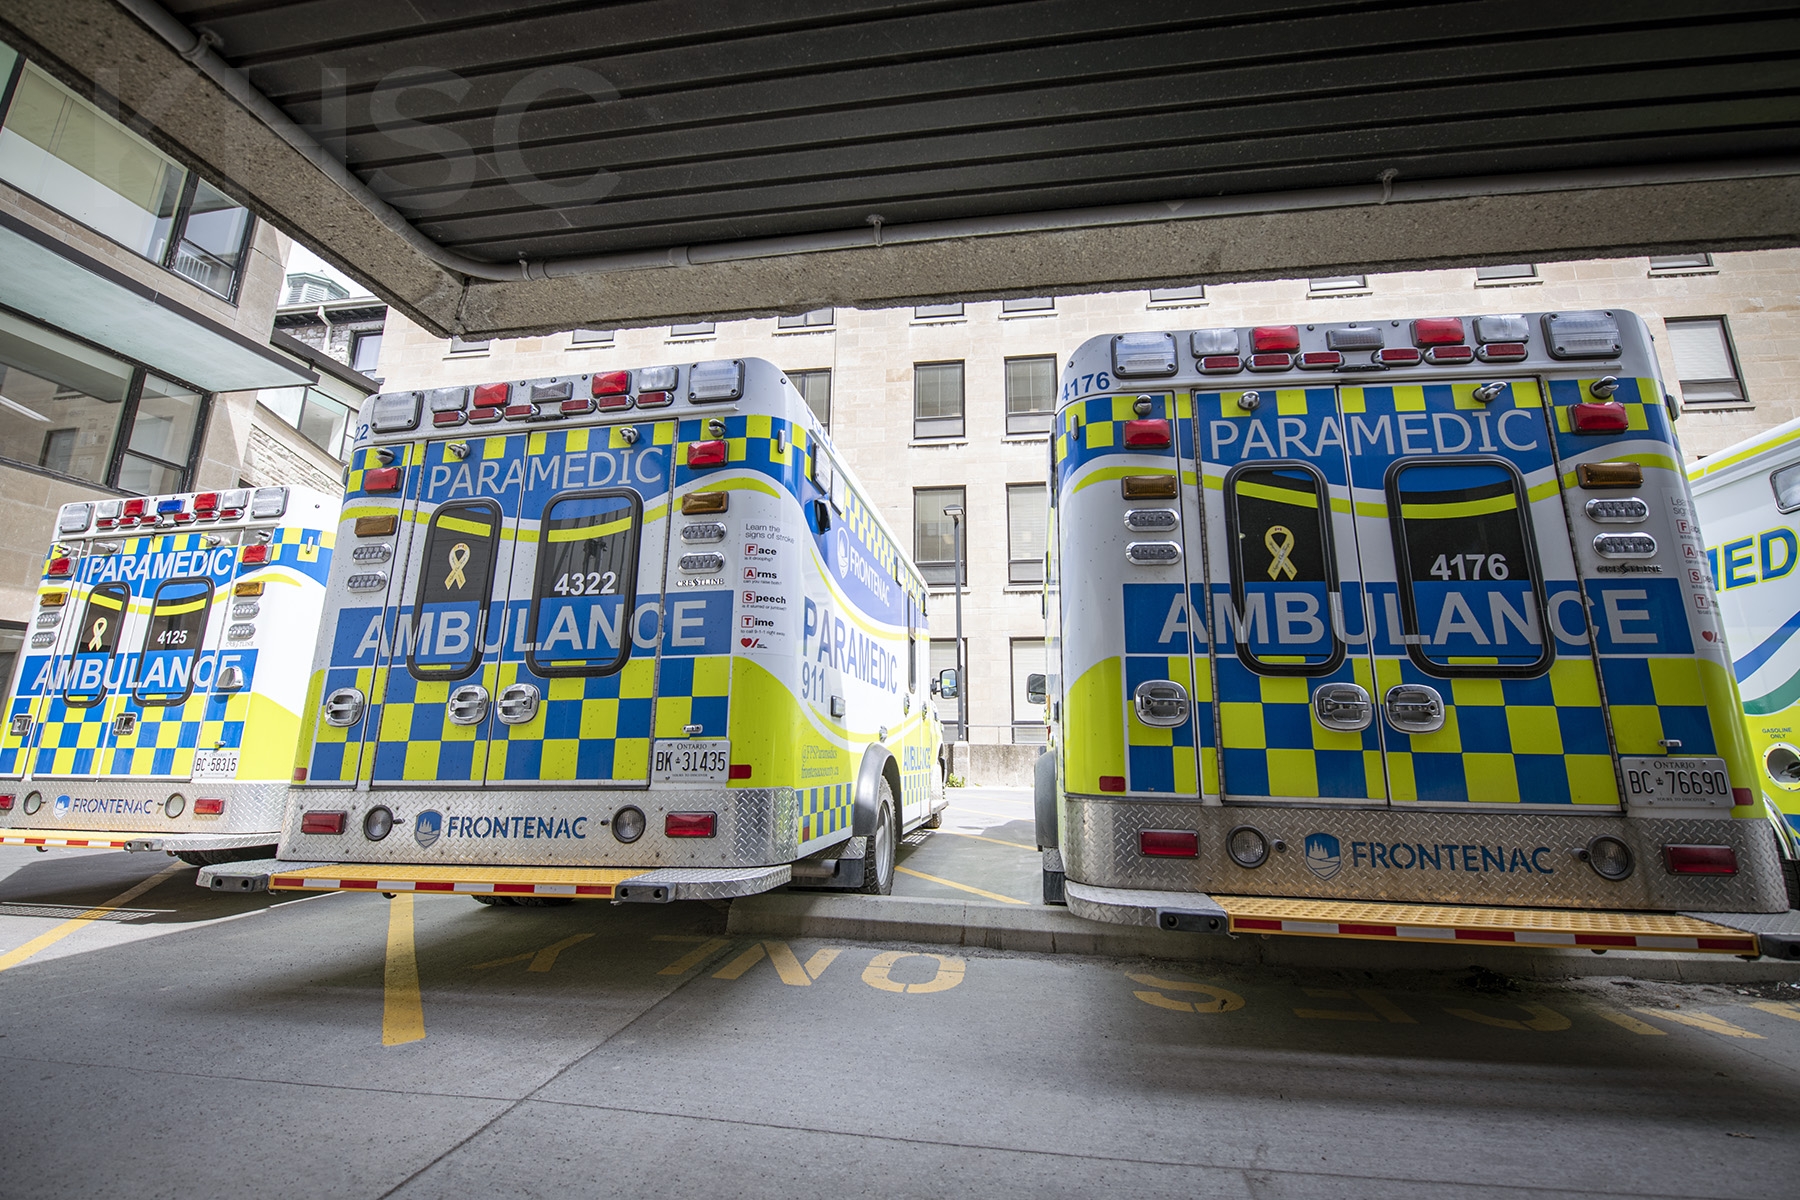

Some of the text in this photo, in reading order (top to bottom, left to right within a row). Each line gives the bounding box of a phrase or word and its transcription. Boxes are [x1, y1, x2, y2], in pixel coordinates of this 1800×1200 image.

[1062, 371, 1110, 401] 4176
[1209, 409, 1538, 460] PARAMEDIC
[427, 447, 664, 500] PARAMEDIC
[745, 523, 768, 531] Learn
[745, 531, 766, 540] signs
[747, 545, 778, 556] Face
[86, 547, 234, 583] PARAMEDIC
[745, 569, 778, 580] Arms
[851, 545, 890, 607] FRONTENAC
[1429, 553, 1510, 580] 4176
[553, 571, 617, 596] 4322
[745, 593, 786, 604] Speech
[354, 600, 706, 659] AMBULANCE
[744, 617, 775, 627] Time
[1158, 589, 1658, 645] AMBULANCE
[157, 630, 188, 645] 4125
[803, 596, 898, 695] PARAMEDIC
[31, 655, 242, 691] AMBULANCE
[802, 661, 826, 703] 911
[1653, 761, 1696, 770] ONTARIO
[72, 798, 153, 815] FRONTENAC
[447, 816, 587, 840] FRONTENAC
[1352, 842, 1555, 875] FRONTENAC
